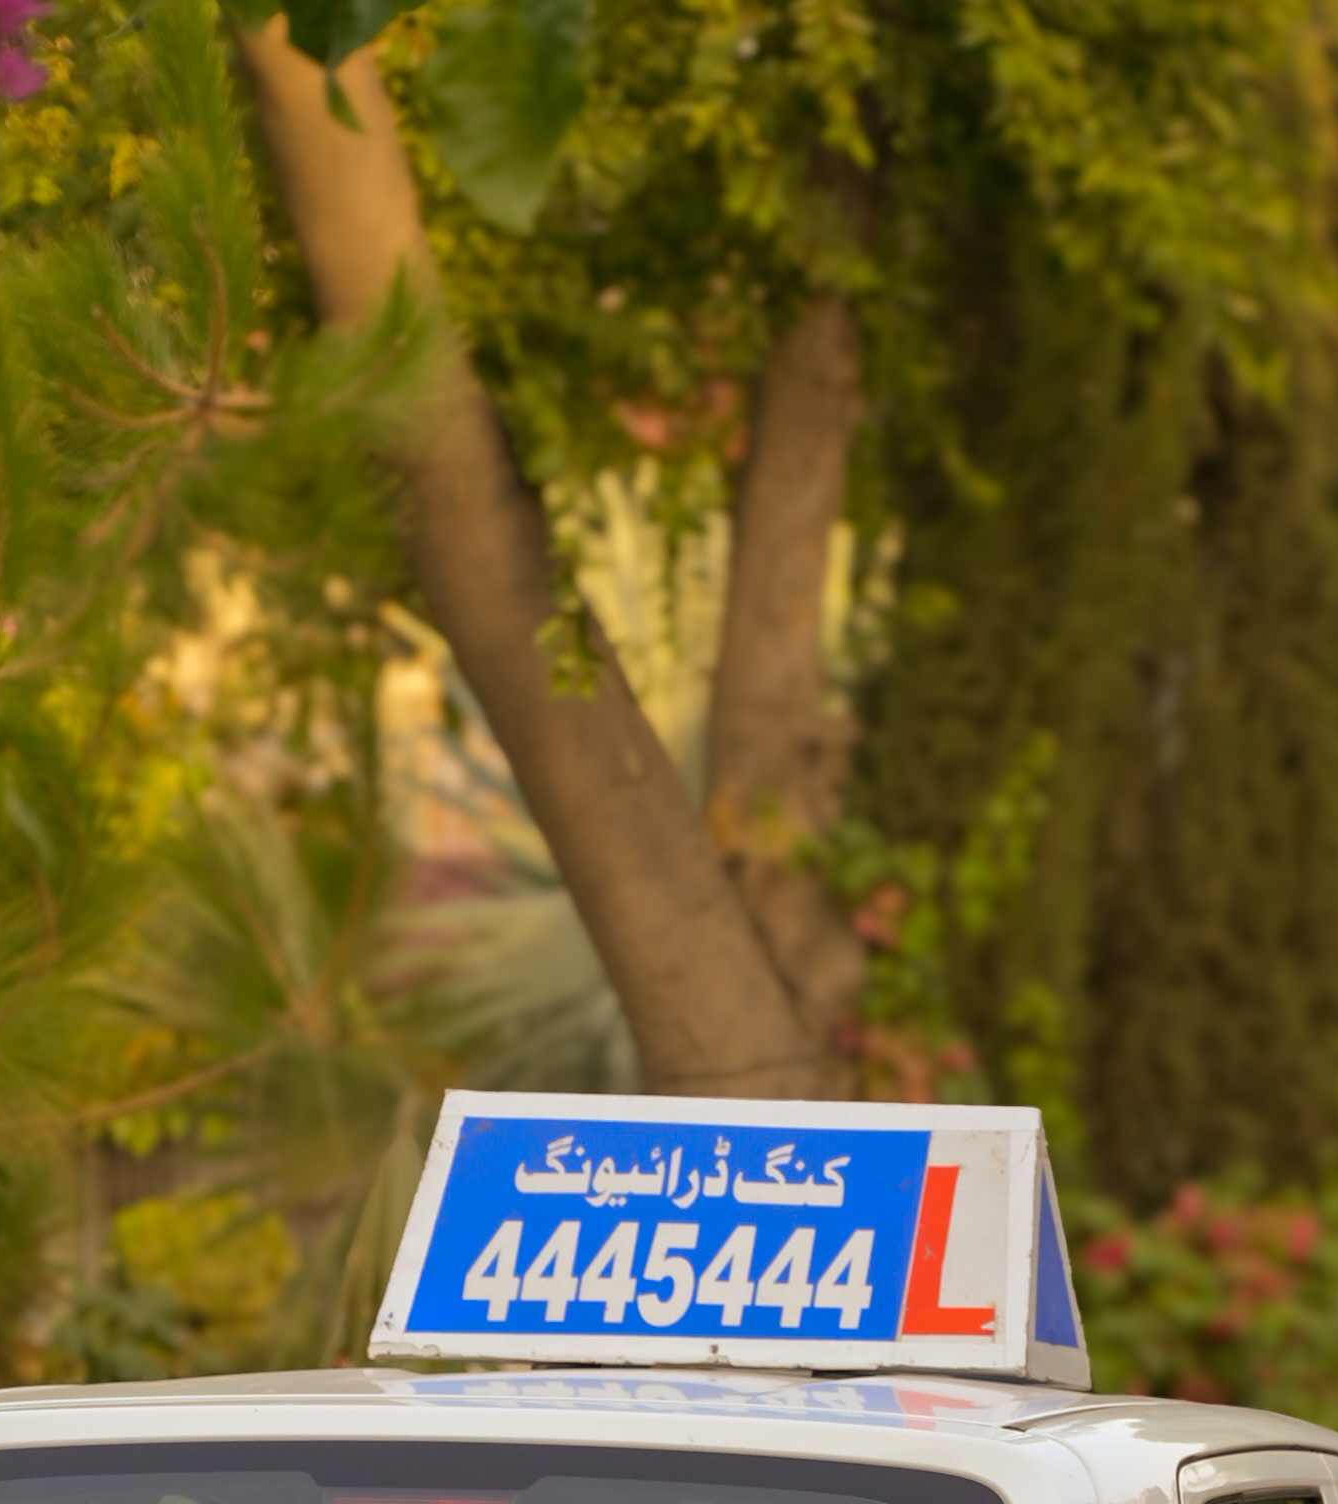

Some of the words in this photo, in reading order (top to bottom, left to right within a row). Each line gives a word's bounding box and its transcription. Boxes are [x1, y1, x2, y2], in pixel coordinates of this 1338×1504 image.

[732, 1142, 852, 1208] کنگ
[462, 1219, 875, 1329] 4445444
[902, 1165, 995, 1335] L
